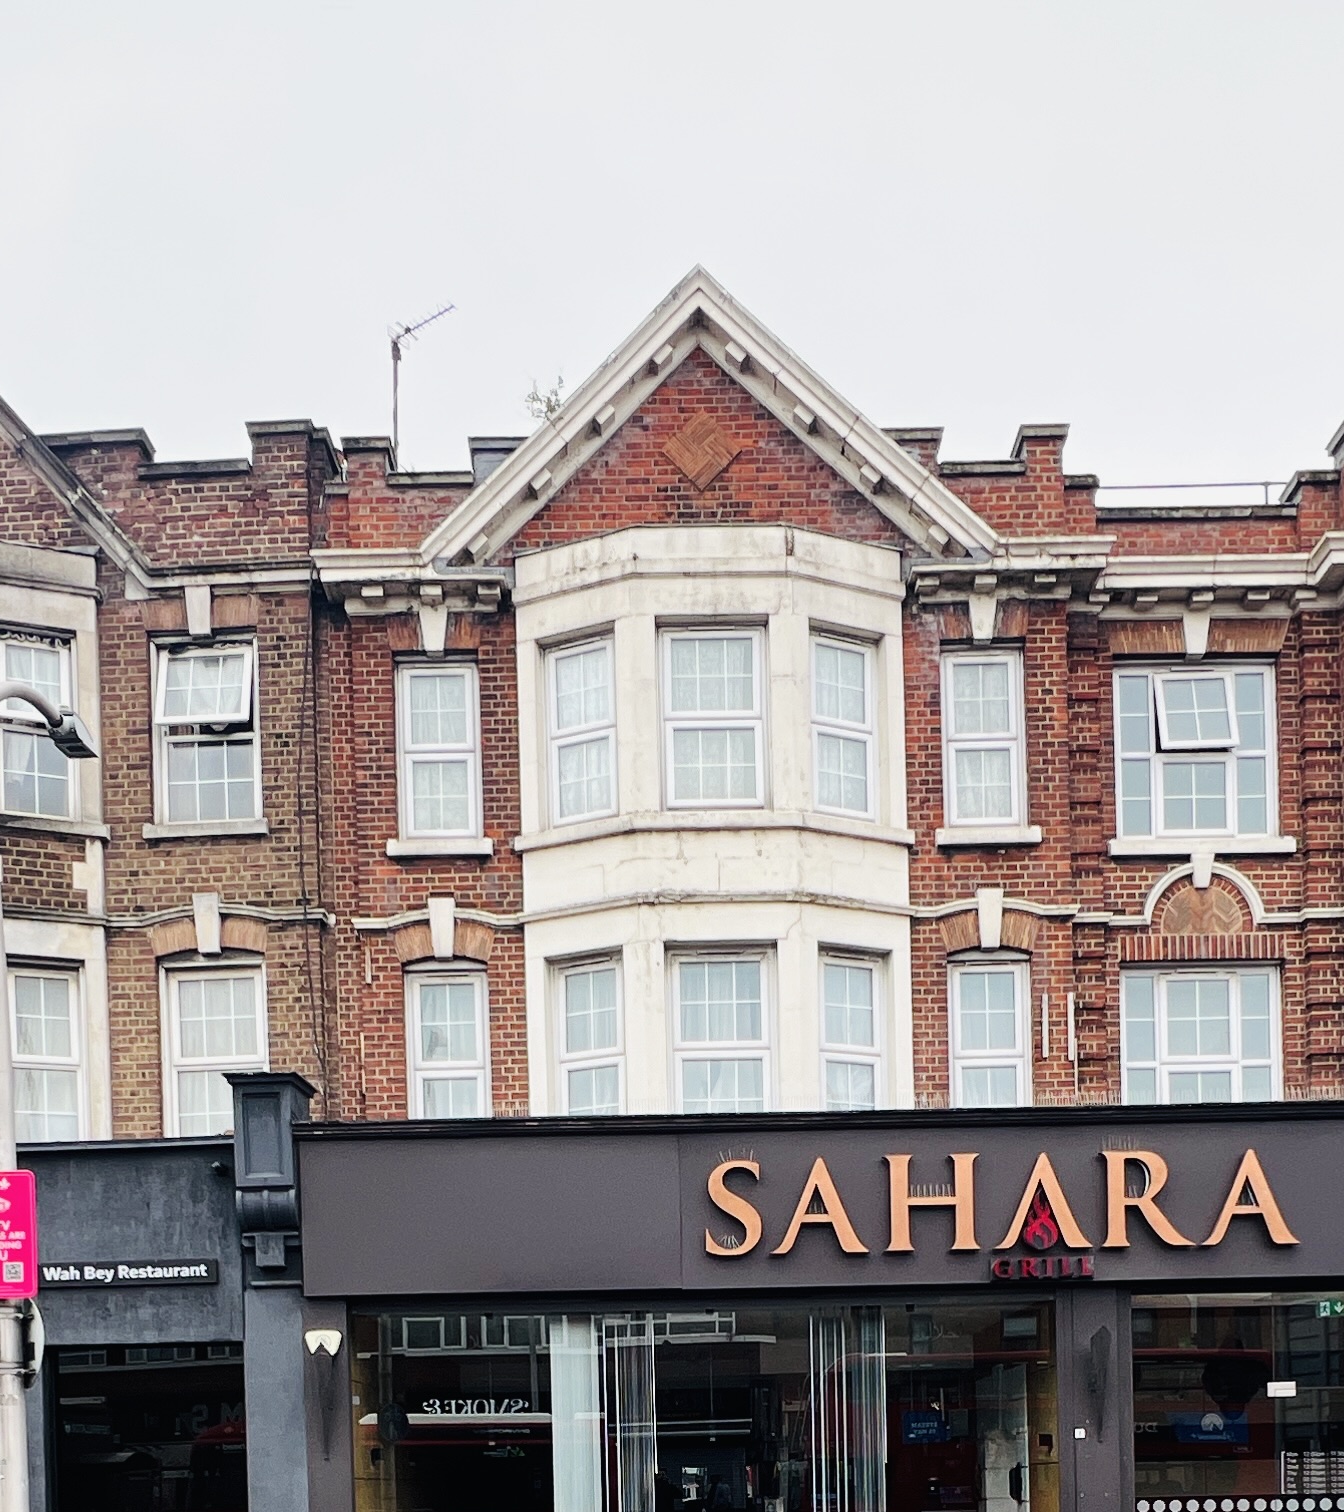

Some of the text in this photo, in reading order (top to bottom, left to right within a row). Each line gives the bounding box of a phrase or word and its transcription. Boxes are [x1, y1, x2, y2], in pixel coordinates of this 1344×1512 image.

[705, 1148, 1301, 1257] SAHARA
[43, 1263, 208, 1283] Wah Bey Restaurant
[991, 1255, 1094, 1279] GRILL
